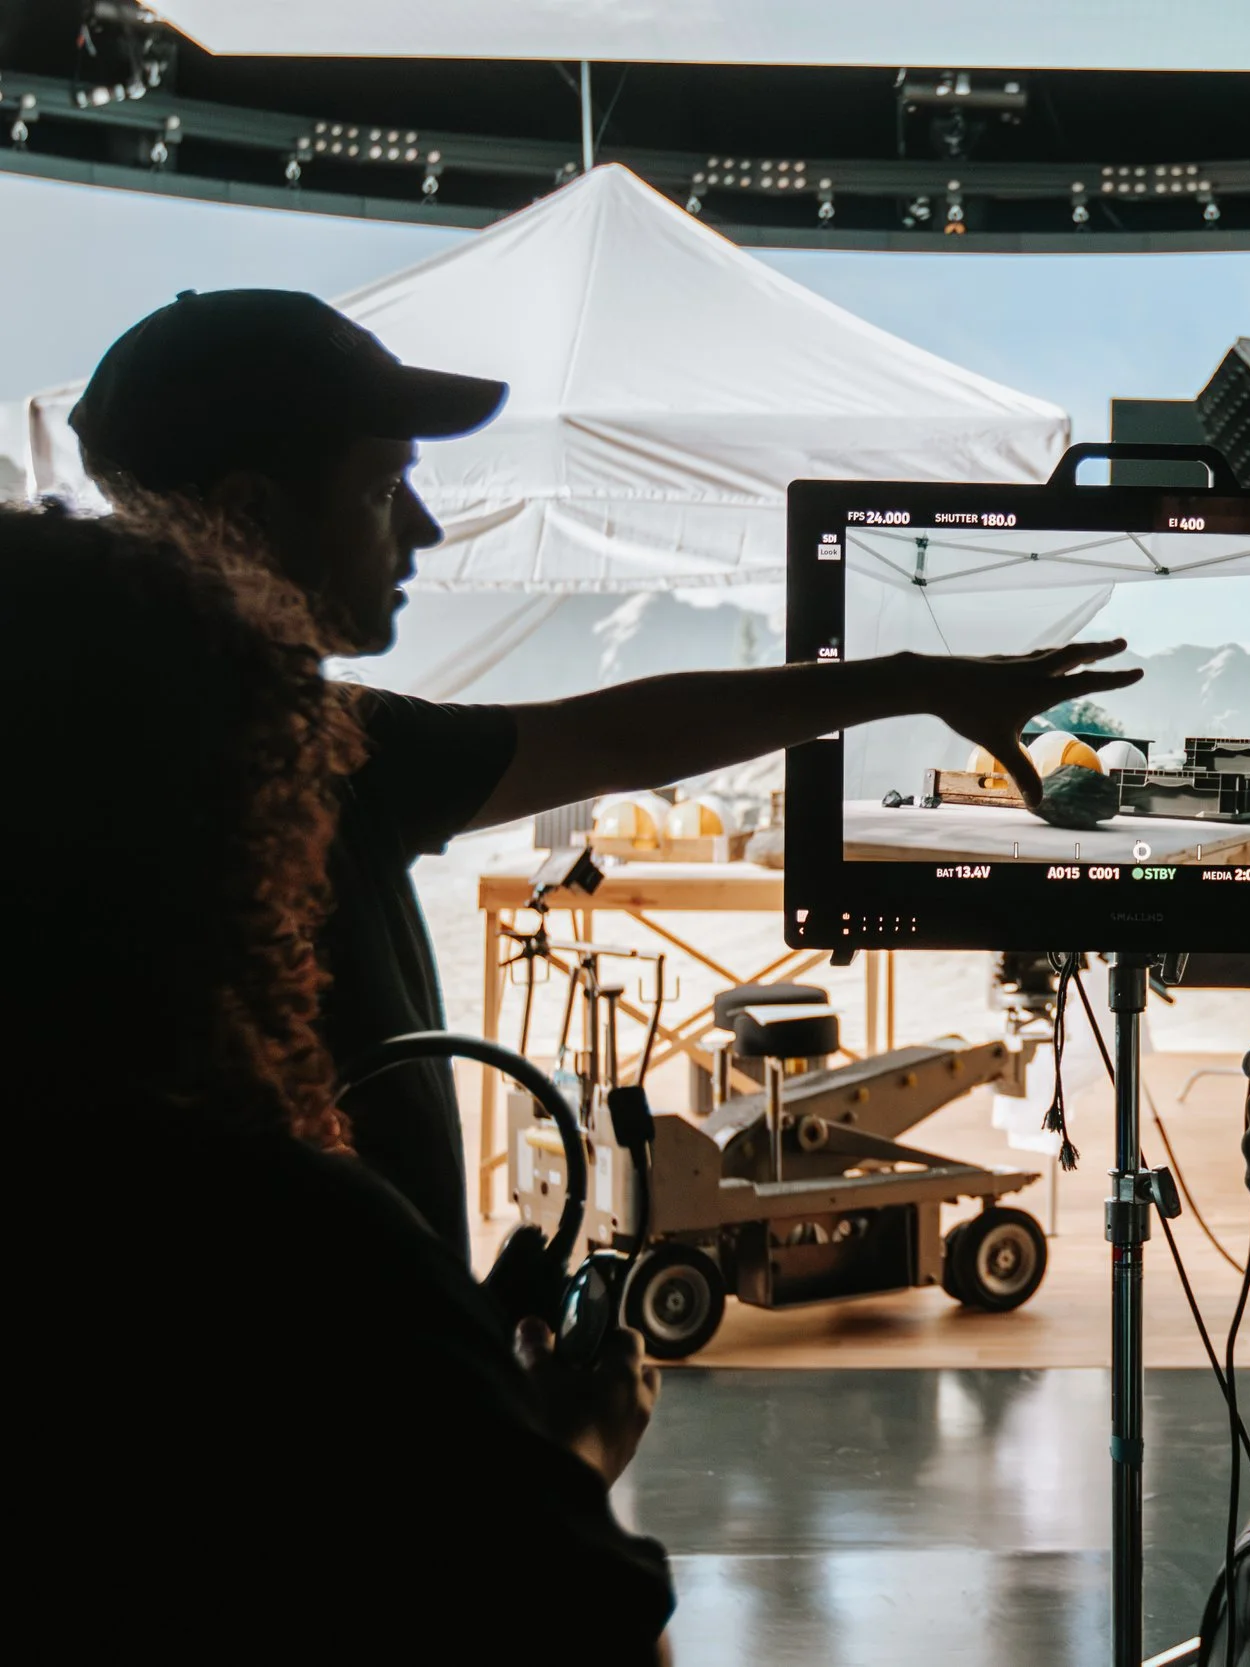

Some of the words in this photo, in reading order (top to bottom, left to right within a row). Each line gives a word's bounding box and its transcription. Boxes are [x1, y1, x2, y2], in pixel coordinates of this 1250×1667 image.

[848, 511, 865, 521] FPS
[866, 511, 910, 525] 24.000
[935, 513, 978, 524] SHUTTER
[981, 514, 1016, 526] 180.0
[1169, 518, 1178, 528] EI
[1180, 518, 1205, 531] 400
[822, 534, 837, 543] SDI
[820, 547, 838, 556] Look
[819, 648, 838, 658] CAM
[936, 868, 954, 878] BAT
[955, 866, 991, 879] 13.4V
[1047, 866, 1081, 880] A015
[1088, 867, 1120, 880] C001
[1144, 868, 1176, 880] STBY
[1202, 871, 1233, 881] MEDIA
